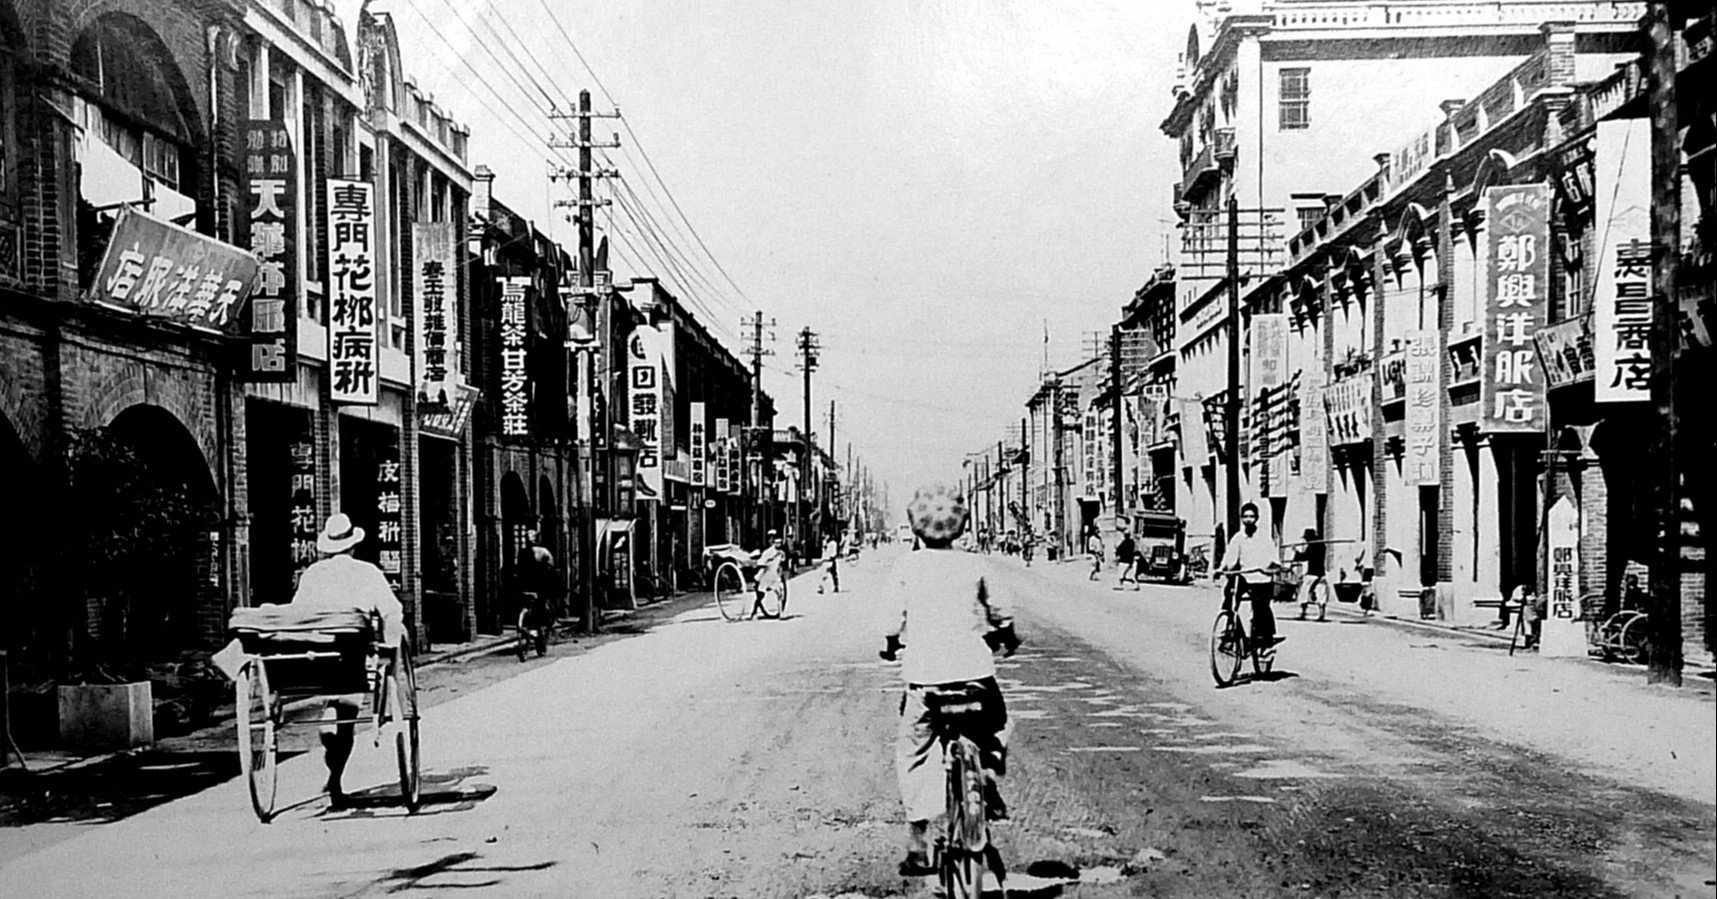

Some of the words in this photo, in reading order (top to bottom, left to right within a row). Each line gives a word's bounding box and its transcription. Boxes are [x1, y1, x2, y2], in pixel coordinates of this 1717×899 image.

[107, 241, 242, 325] 天華洋服店
[1493, 234, 1536, 423] 鄭興洋服店
